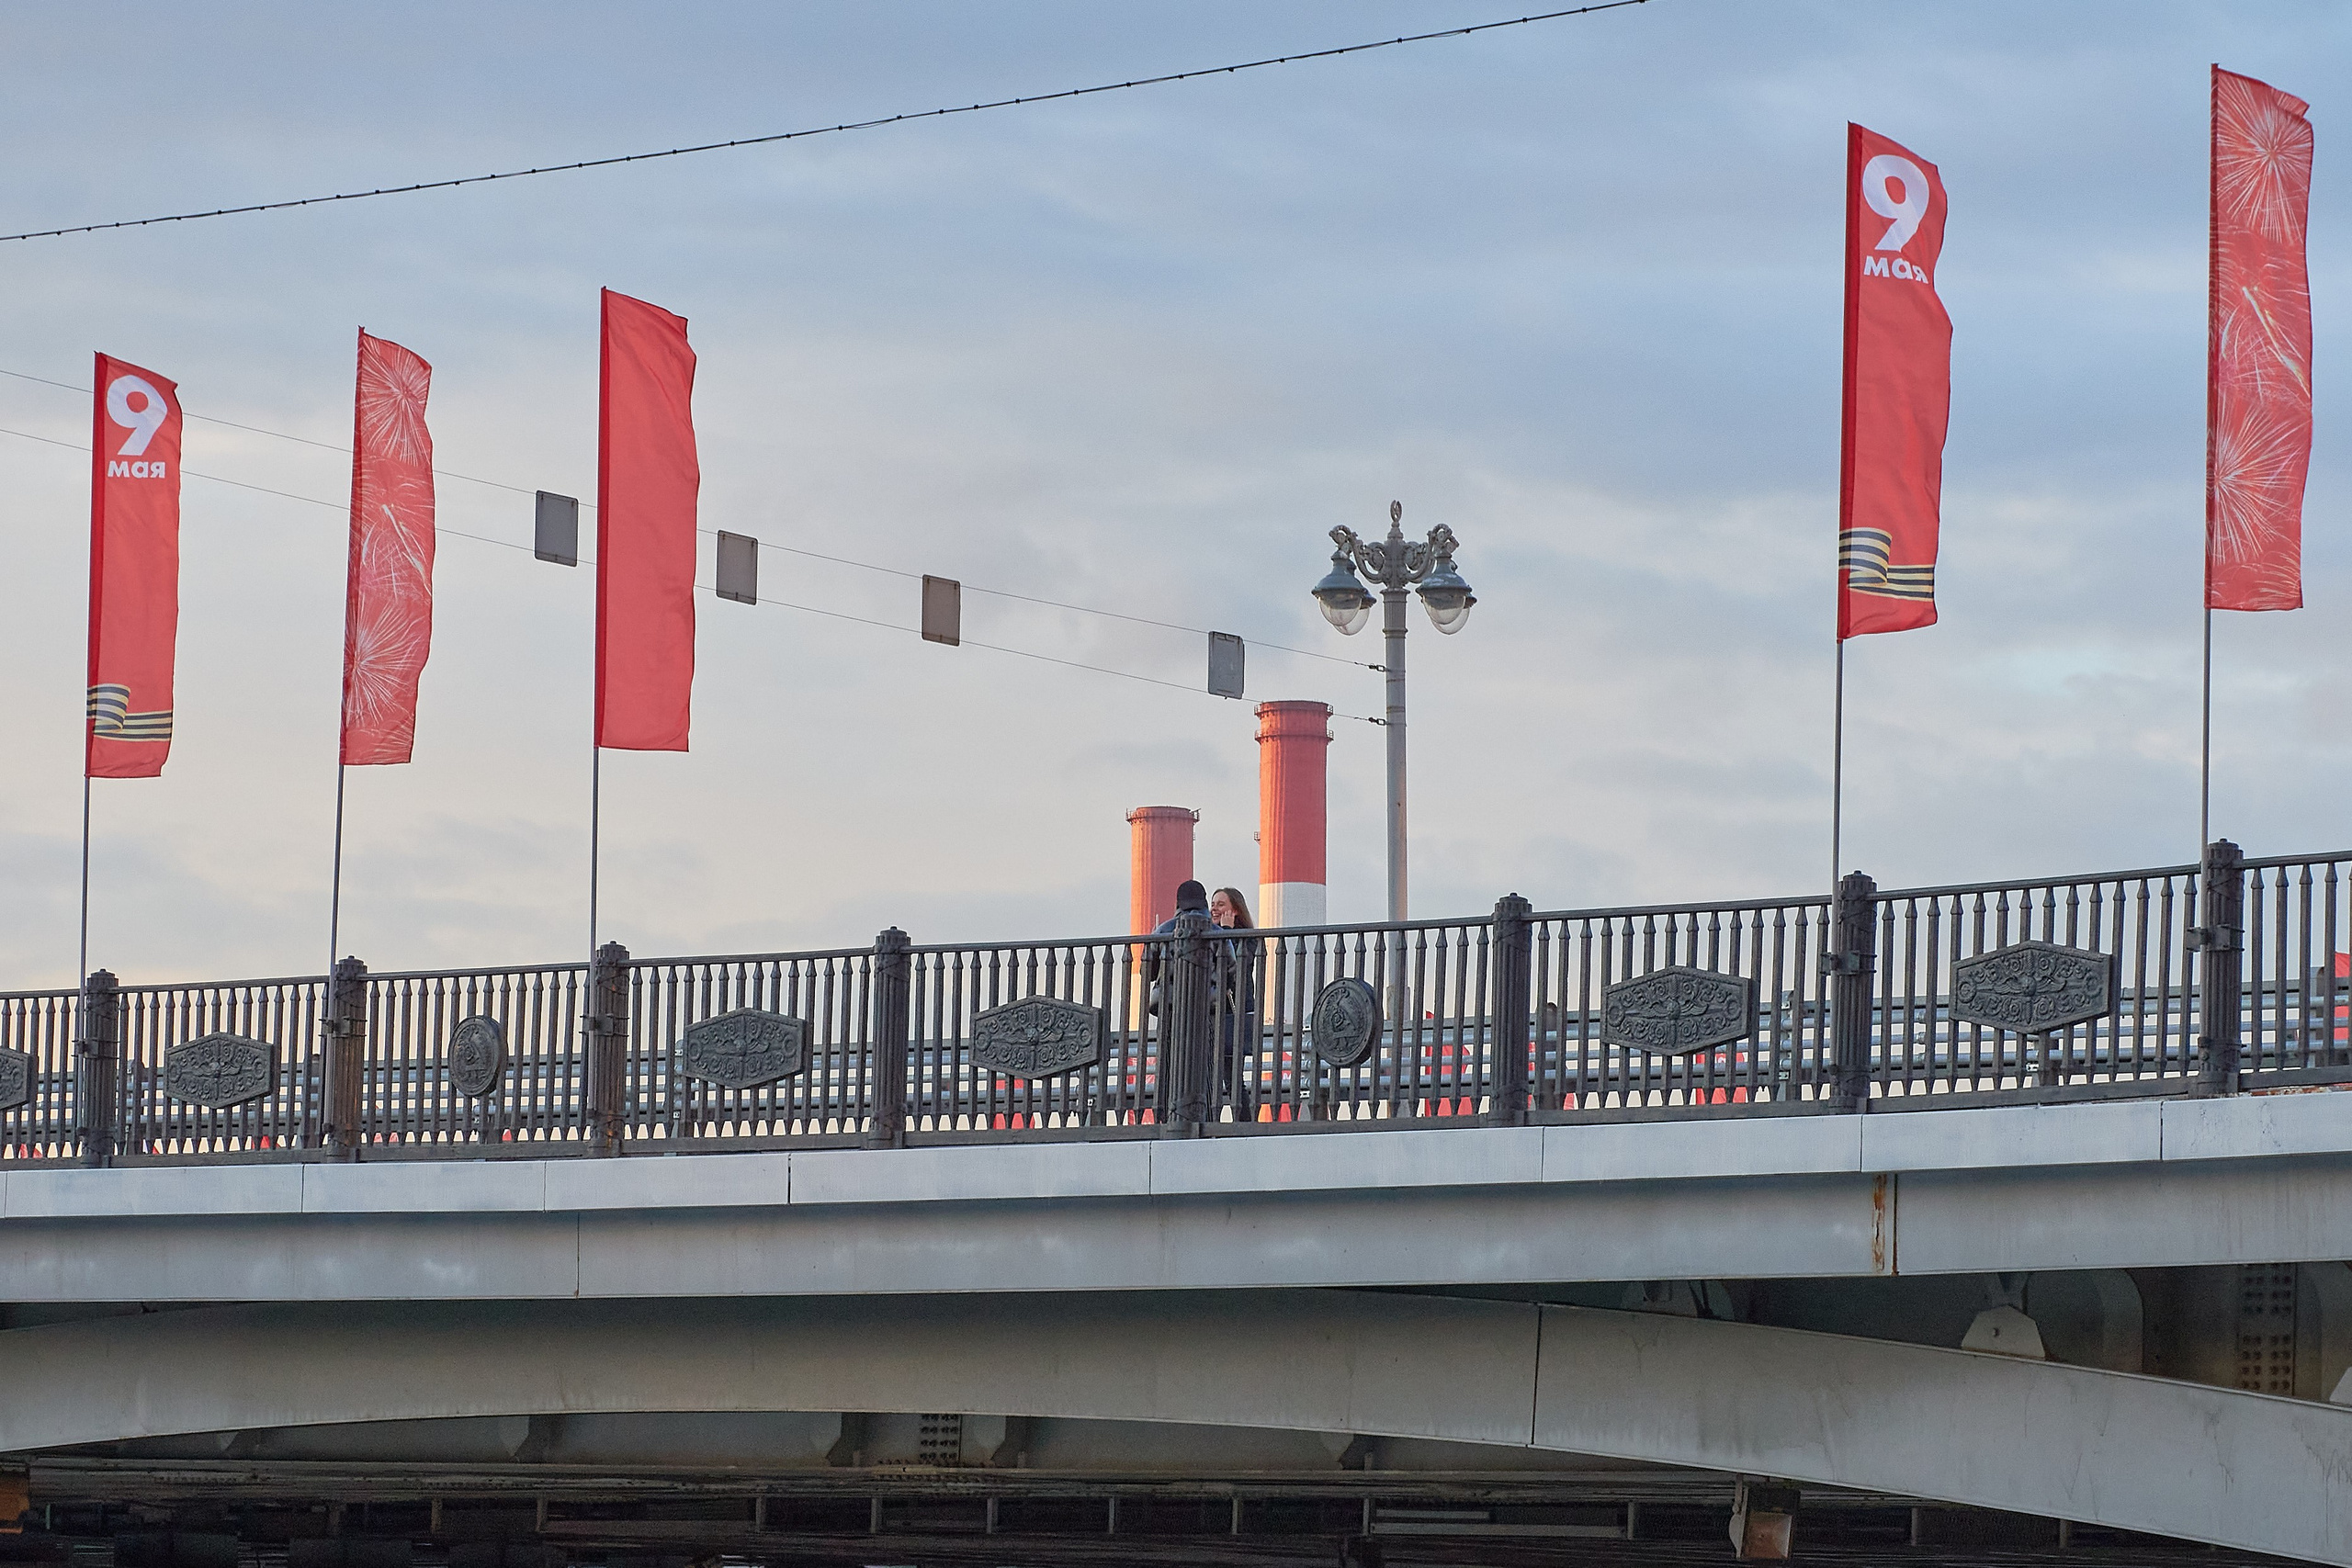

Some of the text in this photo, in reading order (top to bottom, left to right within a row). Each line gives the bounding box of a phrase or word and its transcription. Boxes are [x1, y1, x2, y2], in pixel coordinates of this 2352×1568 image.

[1862, 154, 1929, 253] 9
[1863, 255, 1928, 284] мая
[107, 375, 168, 456] 9
[107, 460, 165, 479] мая
